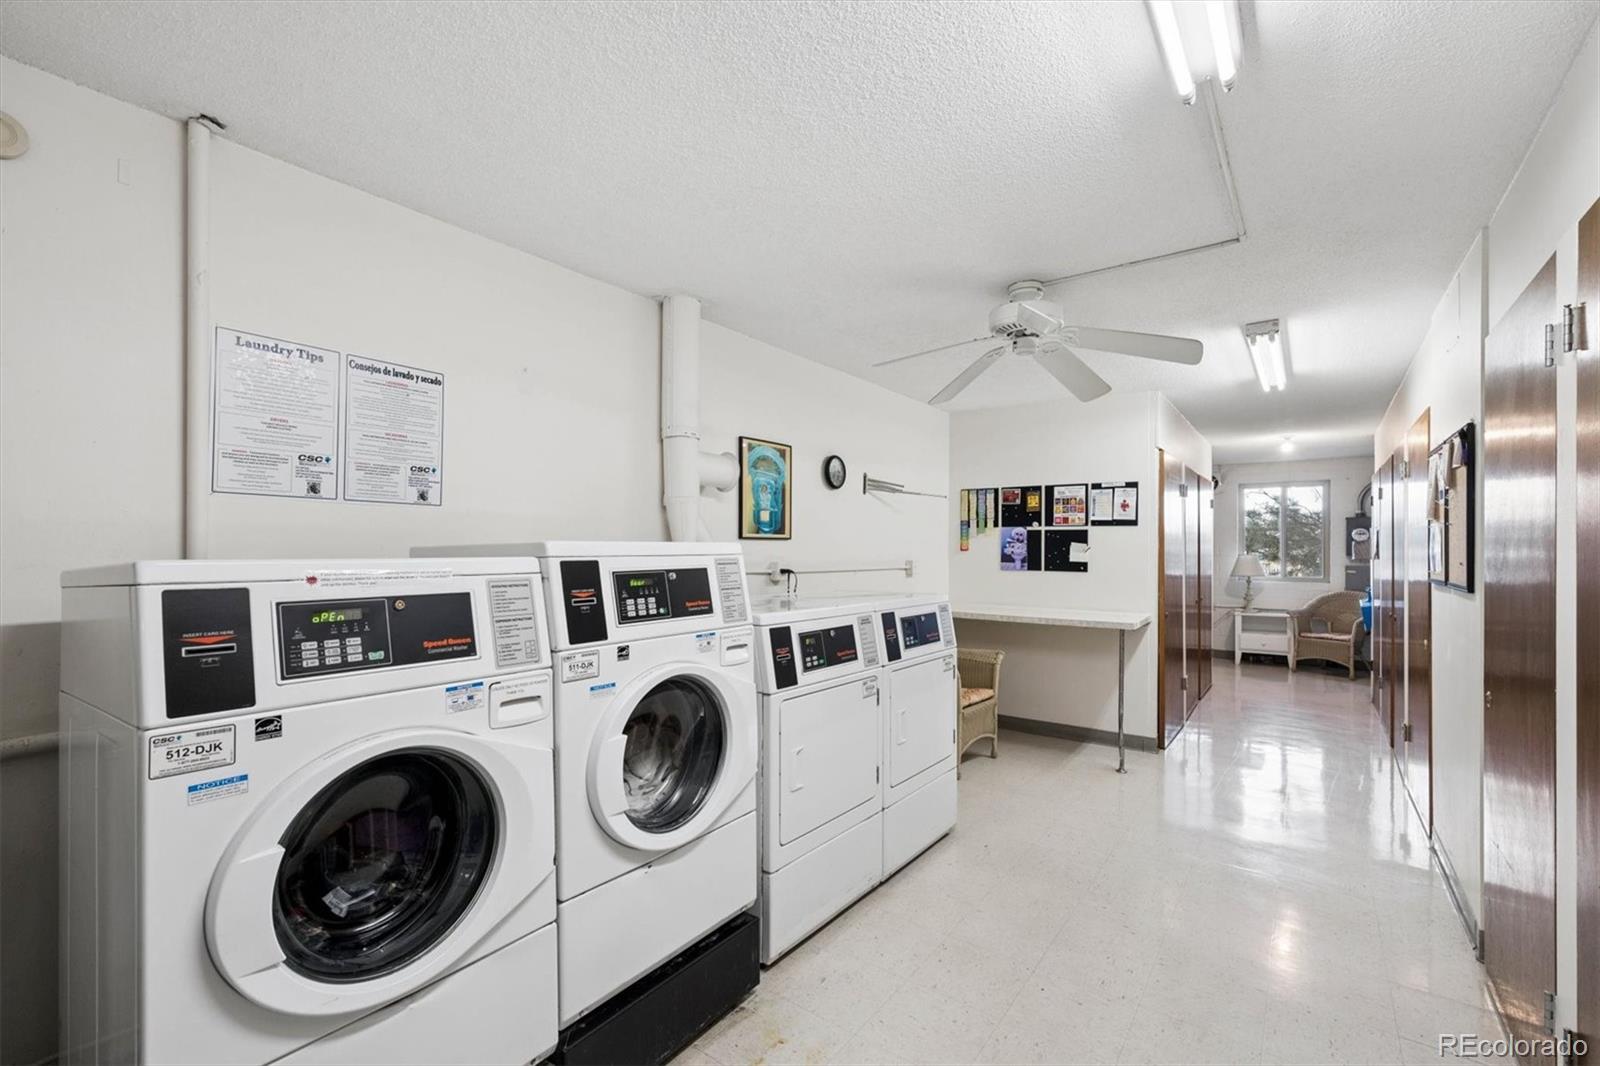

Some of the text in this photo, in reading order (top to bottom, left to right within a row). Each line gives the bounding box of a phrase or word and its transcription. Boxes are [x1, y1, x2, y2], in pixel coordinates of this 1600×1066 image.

[235, 336, 324, 363] Laundry Tips
[349, 359, 442, 386] Consejos de lavado y secado
[298, 454, 324, 463] CSC
[410, 465, 431, 474] CSC
[423, 639, 447, 648] Speed
[153, 736, 175, 745] CSC
[166, 742, 223, 760] 512-DJK
[197, 776, 241, 791] NOTICE
